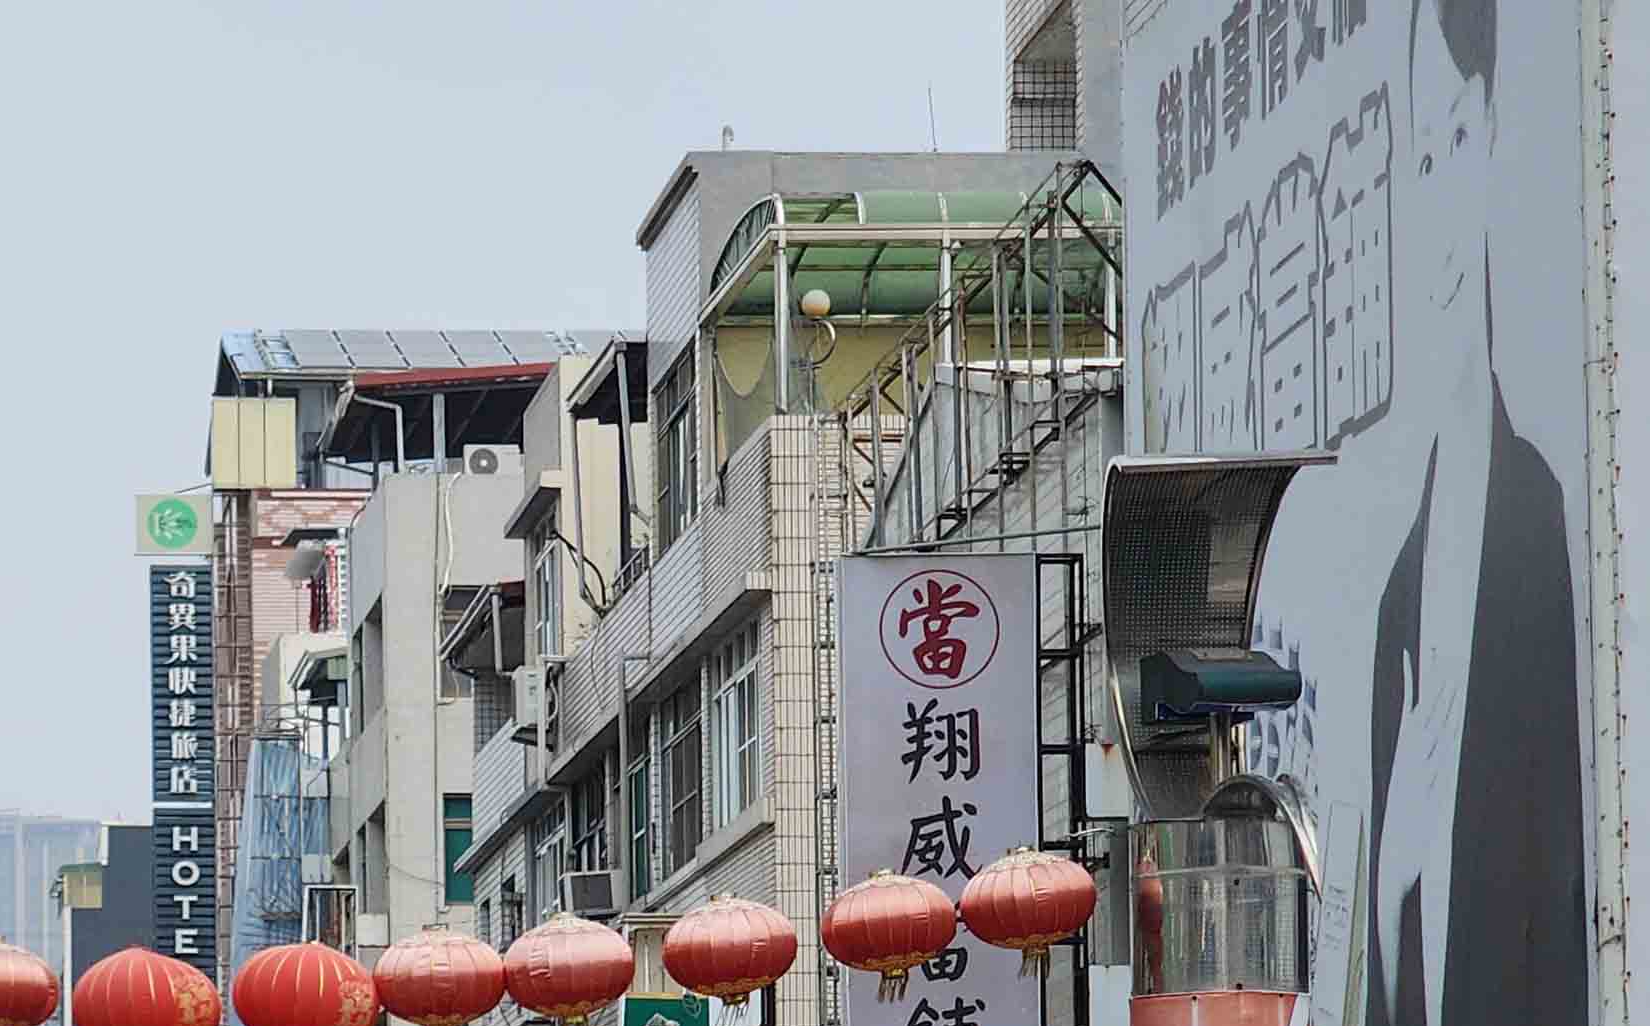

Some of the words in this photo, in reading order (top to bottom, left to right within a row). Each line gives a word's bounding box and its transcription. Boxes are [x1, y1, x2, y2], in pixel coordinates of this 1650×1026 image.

[163, 571, 199, 794] 奇異果快捷旅店
[899, 579, 980, 680] 當
[171, 826, 200, 954] HOTE
